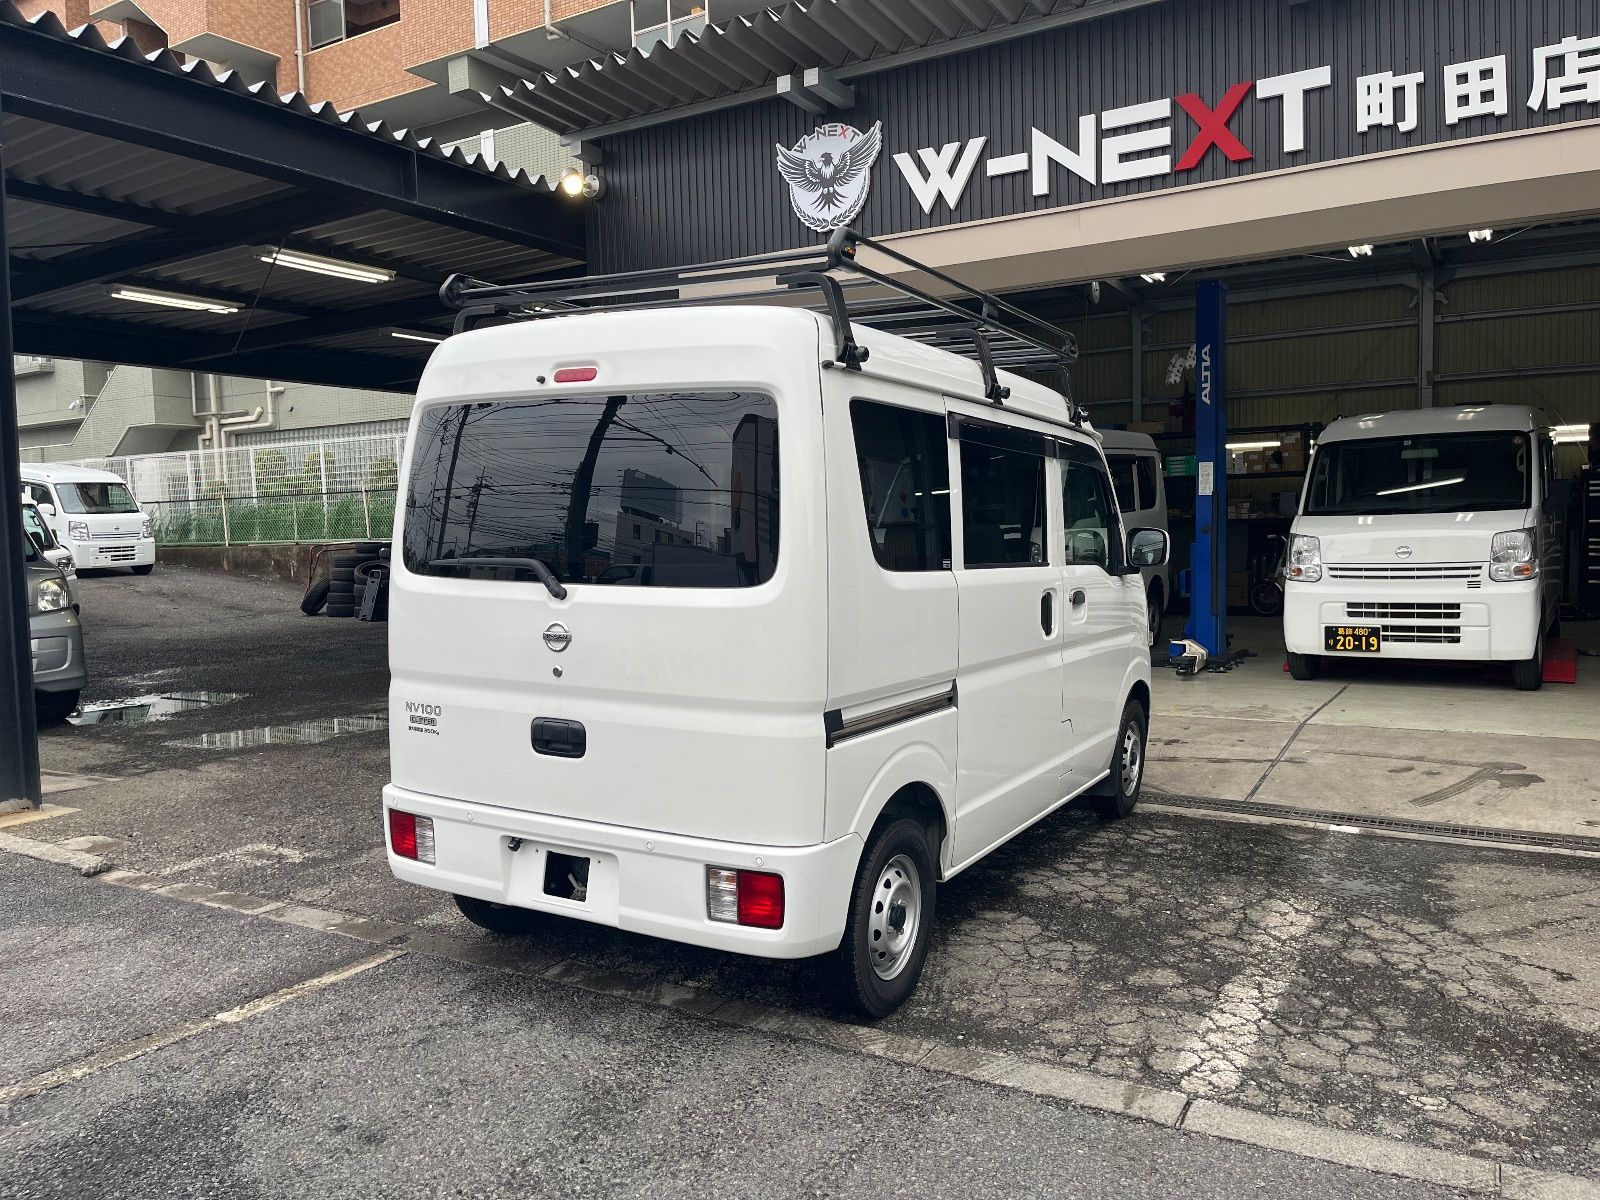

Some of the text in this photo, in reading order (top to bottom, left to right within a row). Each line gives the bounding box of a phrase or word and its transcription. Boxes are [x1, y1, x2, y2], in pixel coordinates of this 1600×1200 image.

[793, 123, 861, 154] W-NEXT
[893, 36, 1600, 215] W-NEXT 町田店
[1201, 343, 1211, 405] ALTIA
[1336, 636, 1378, 651] 20-19
[405, 701, 442, 716] NV100
